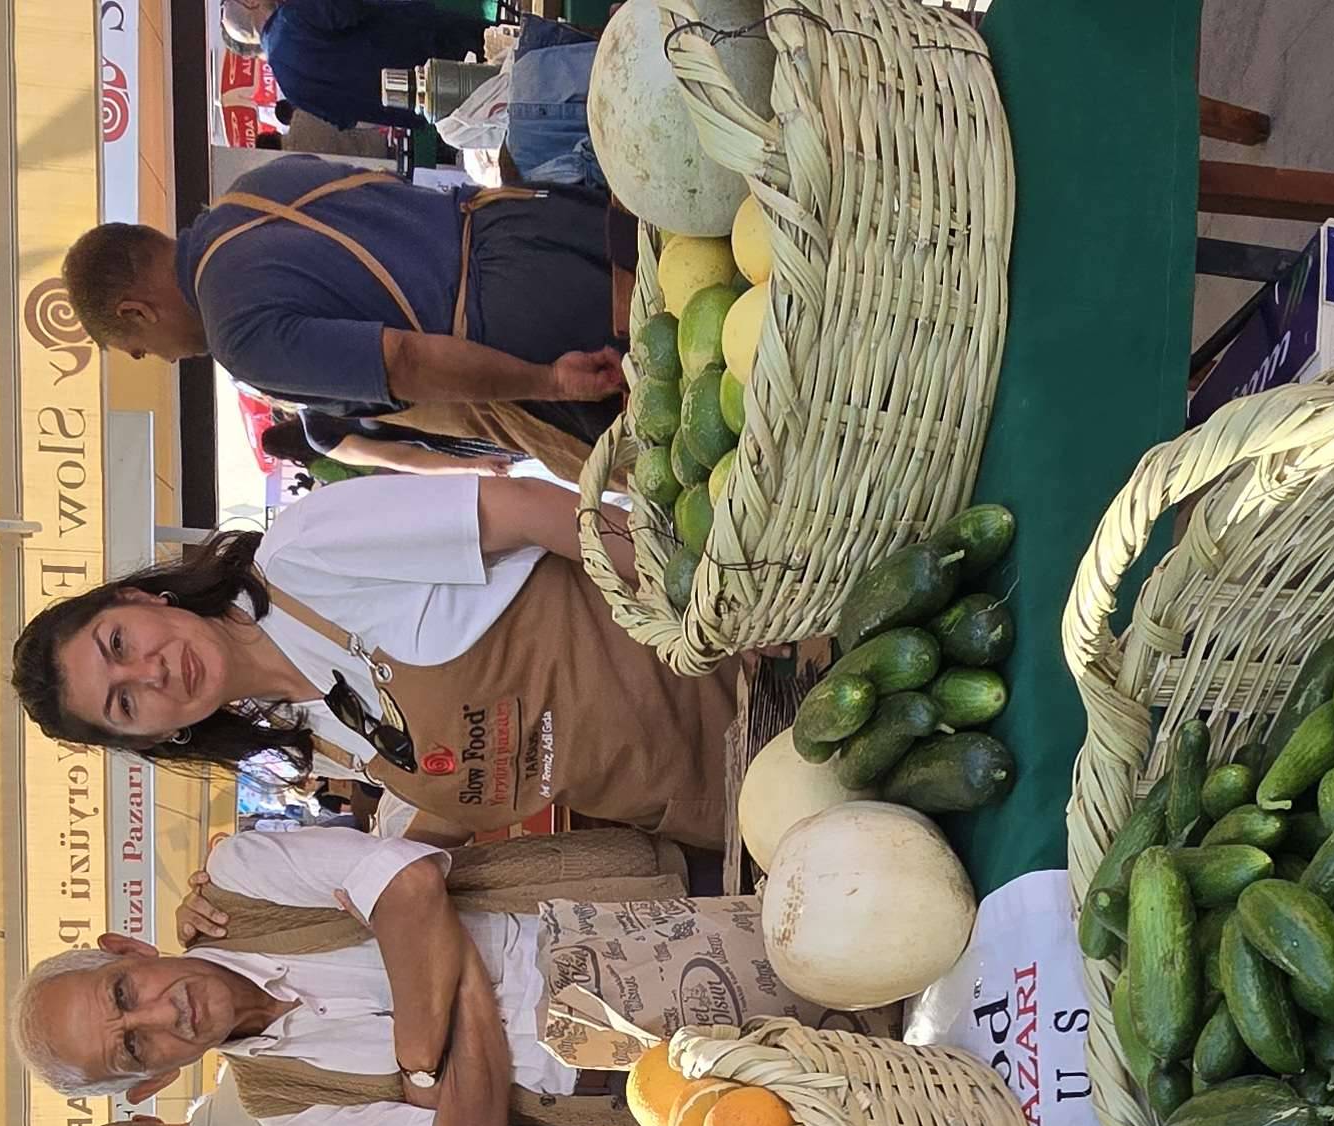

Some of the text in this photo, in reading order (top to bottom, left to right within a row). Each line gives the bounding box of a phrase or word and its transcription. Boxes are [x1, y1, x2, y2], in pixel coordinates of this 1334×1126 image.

[525, 732, 538, 780] TARSUS
[459, 768, 485, 805] Slow
[122, 765, 143, 862] Pazarı
